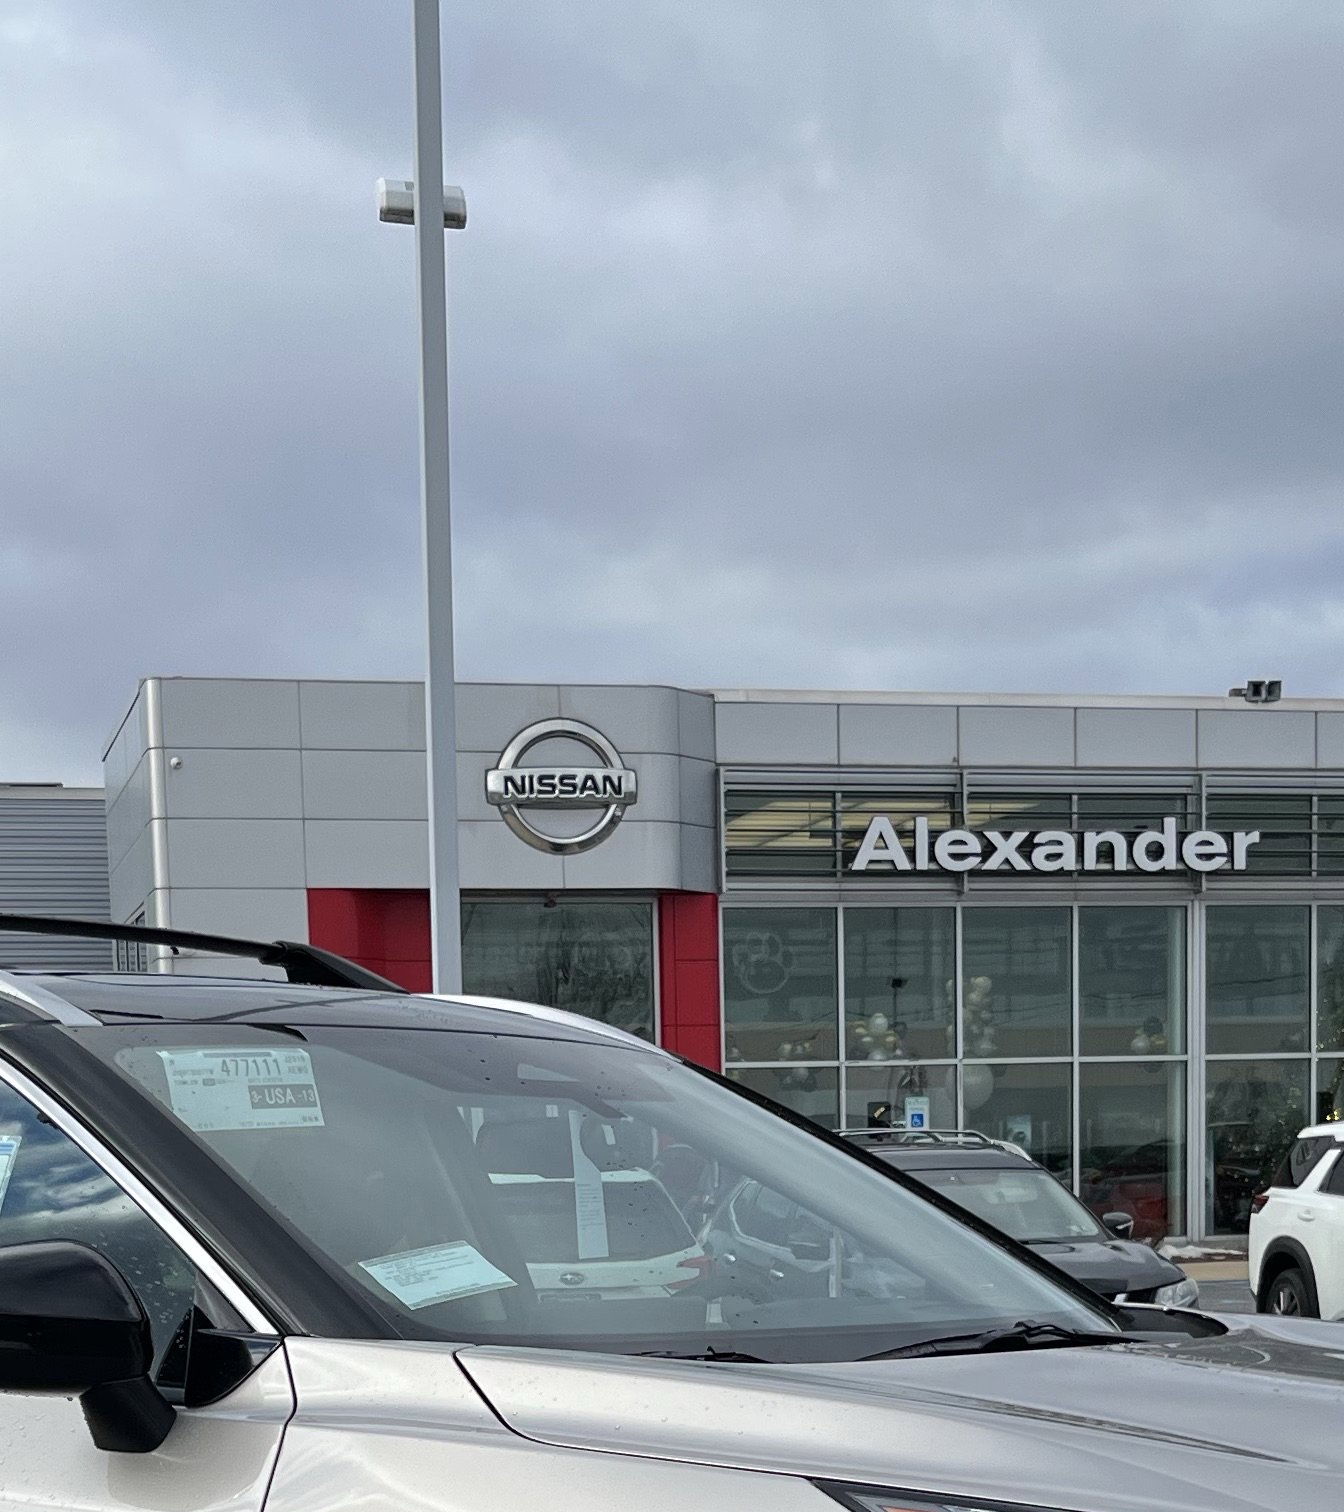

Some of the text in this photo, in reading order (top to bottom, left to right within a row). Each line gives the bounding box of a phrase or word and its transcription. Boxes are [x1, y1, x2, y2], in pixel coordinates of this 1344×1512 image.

[503, 774, 623, 798] NISSAN
[851, 816, 1260, 873] Alexander
[221, 1058, 281, 1077] 477111
[265, 1087, 296, 1105] USA
